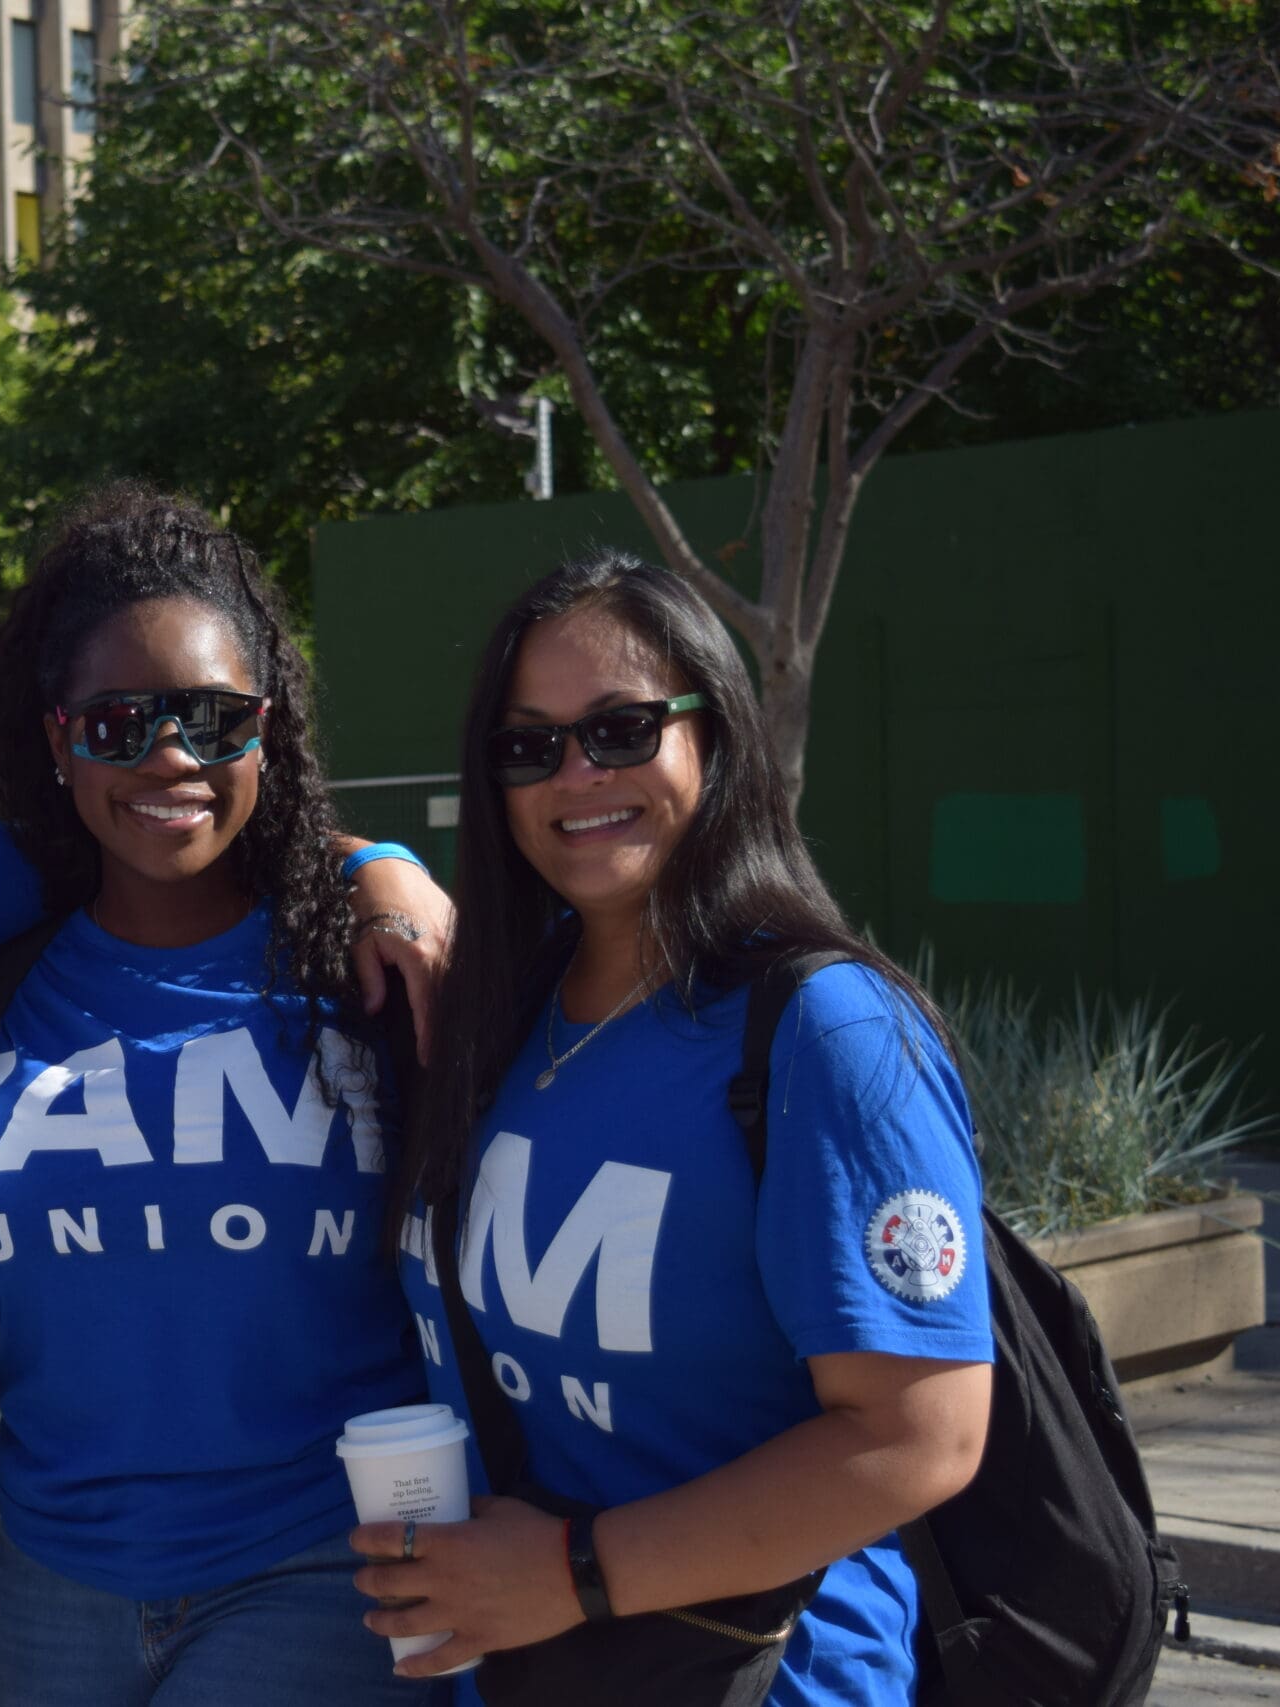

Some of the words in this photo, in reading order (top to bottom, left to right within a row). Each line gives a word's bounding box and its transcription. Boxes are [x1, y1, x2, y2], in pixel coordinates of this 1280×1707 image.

[942, 1254, 951, 1265] M
[392, 1479, 413, 1488] That
[413, 1476, 430, 1485] first
[392, 1490, 405, 1498] sip
[397, 1505, 436, 1516] STARBUCKS
